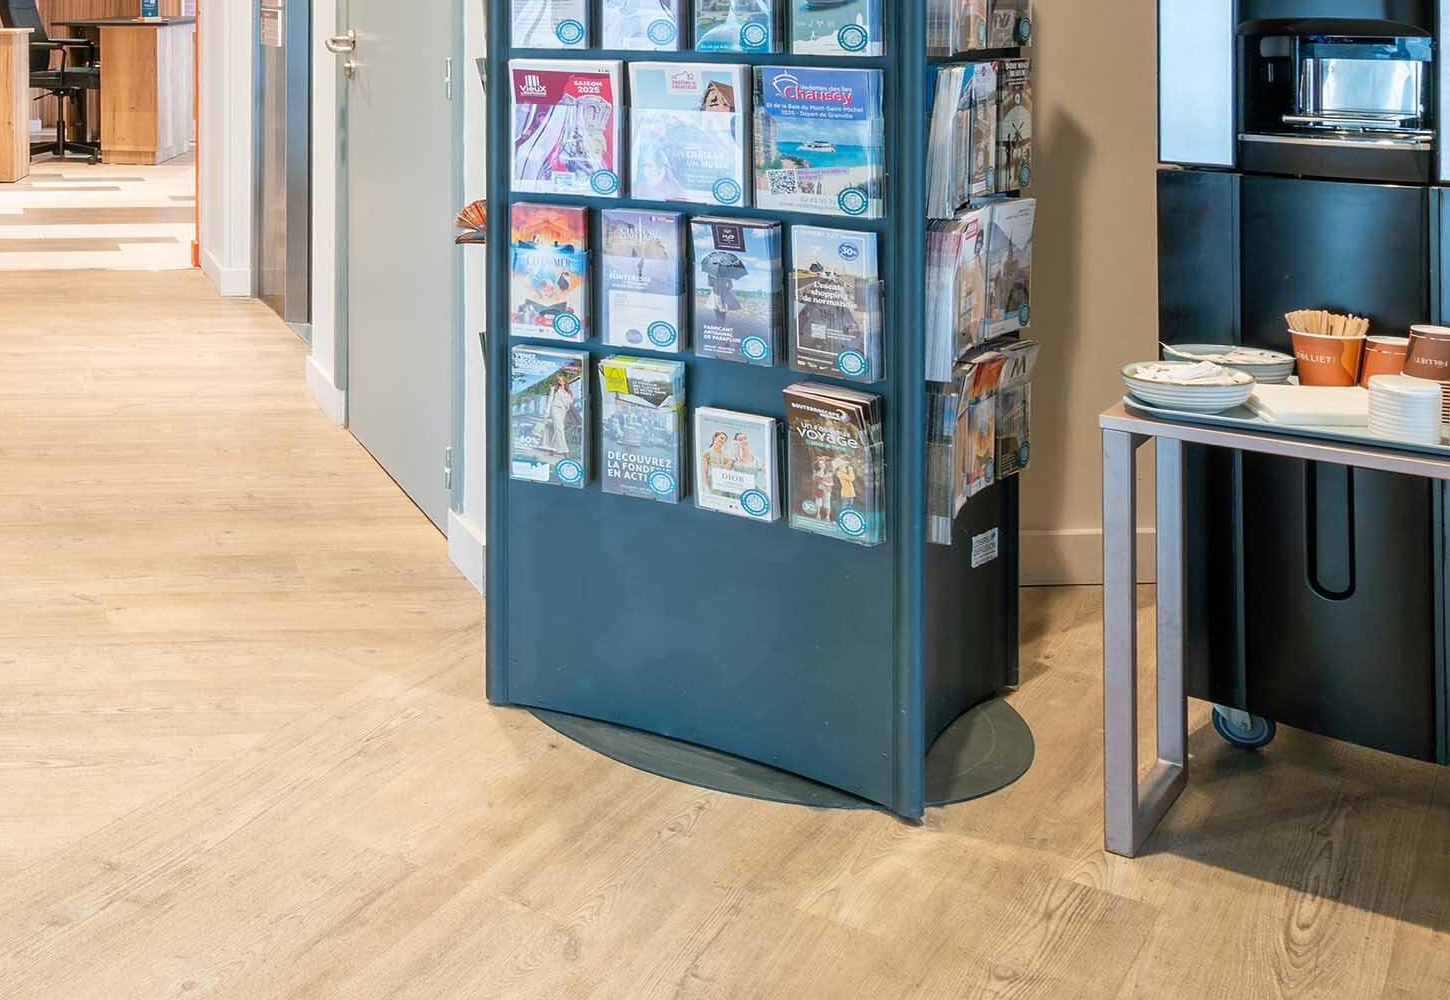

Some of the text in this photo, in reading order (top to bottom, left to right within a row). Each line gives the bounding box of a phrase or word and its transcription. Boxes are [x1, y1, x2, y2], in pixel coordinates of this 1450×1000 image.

[574, 80, 603, 88] SAISON
[577, 86, 600, 94] 2025
[784, 85, 854, 107] Chausey
[608, 460, 619, 469] LA
[608, 469, 621, 478] EN
